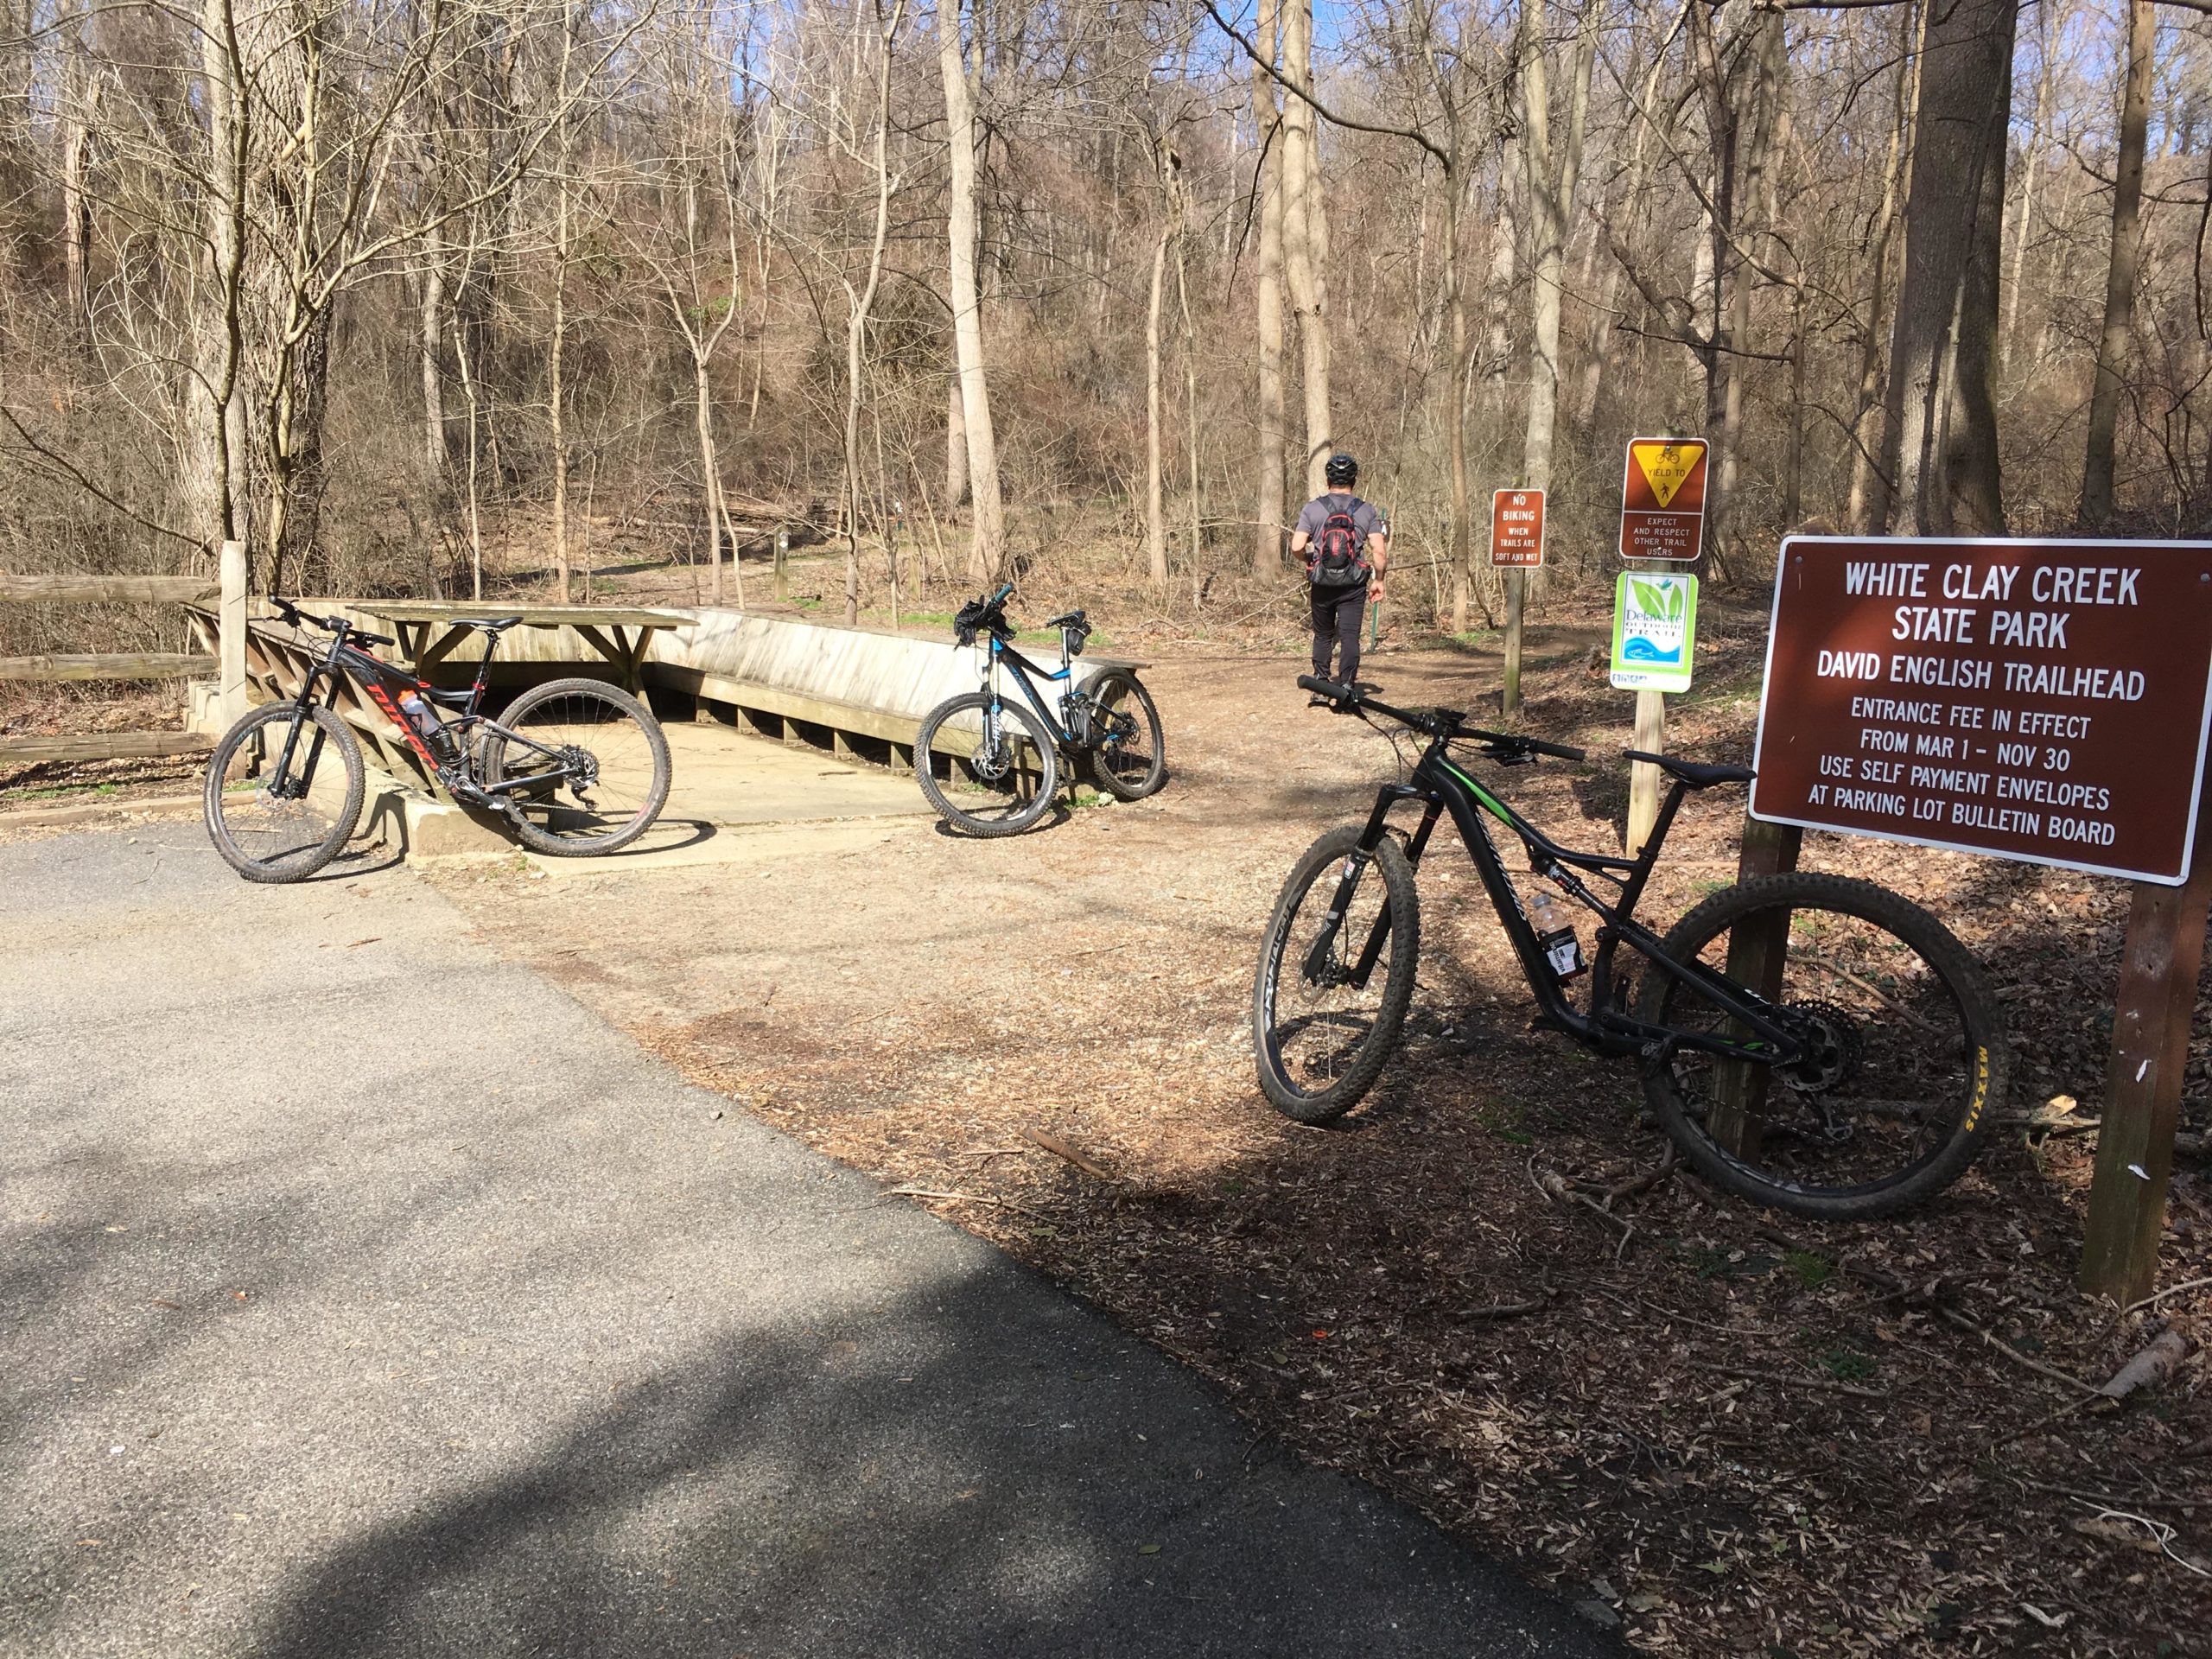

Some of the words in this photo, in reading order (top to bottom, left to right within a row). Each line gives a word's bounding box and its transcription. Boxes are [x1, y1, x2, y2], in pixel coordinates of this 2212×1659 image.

[1647, 468, 1672, 477] YIELD
[1512, 495, 1527, 506] NO
[1502, 511, 1535, 522] BIKING
[1647, 518, 1677, 526] EXPECT
[1508, 527, 1529, 536] WHEN
[1654, 528, 1690, 537] RESPECT
[1500, 538, 1522, 548] TRAILS
[1522, 539, 1535, 548] ARE
[1664, 538, 1687, 547] TRAIL
[1495, 552, 1510, 561] SOFT
[1511, 553, 1524, 562] AND
[1526, 553, 1538, 562] WET
[1846, 562, 1930, 598] WHITE
[1942, 563, 2021, 601] CLAY
[2031, 566, 2142, 606] CREEK
[1625, 609, 1683, 623] Delaware
[1891, 606, 1977, 645] STATE
[1989, 610, 2071, 650] PARK
[1816, 650, 1880, 680] DAVID
[1890, 654, 1993, 690] ENGLISH
[2003, 662, 2145, 702] TRAILHEAD
[1851, 696, 1943, 725] ENTRANCE
[1949, 704, 1985, 729] FEE
[1992, 709, 2012, 732] IN
[2018, 711, 2092, 740] EFFECT
[1859, 728, 1909, 753] FROM
[1915, 735, 1955, 759] MAR
[1961, 740, 1969, 760] 1
[1997, 742, 2037, 768] NOV
[2043, 747, 2071, 772] 30
[1819, 754, 1854, 779] USE
[1859, 760, 1905, 784] SELF
[1910, 765, 1991, 796] PAYMENT
[1996, 775, 2111, 812] ENVELOPES
[1808, 784, 1829, 805] AT
[1834, 787, 1907, 817] PARKING
[1912, 797, 1947, 823] LOT
[1951, 802, 2042, 836] BULLETIN
[2047, 816, 2116, 847] BOARD
[1965, 1045, 1989, 1133] MAXXIS
